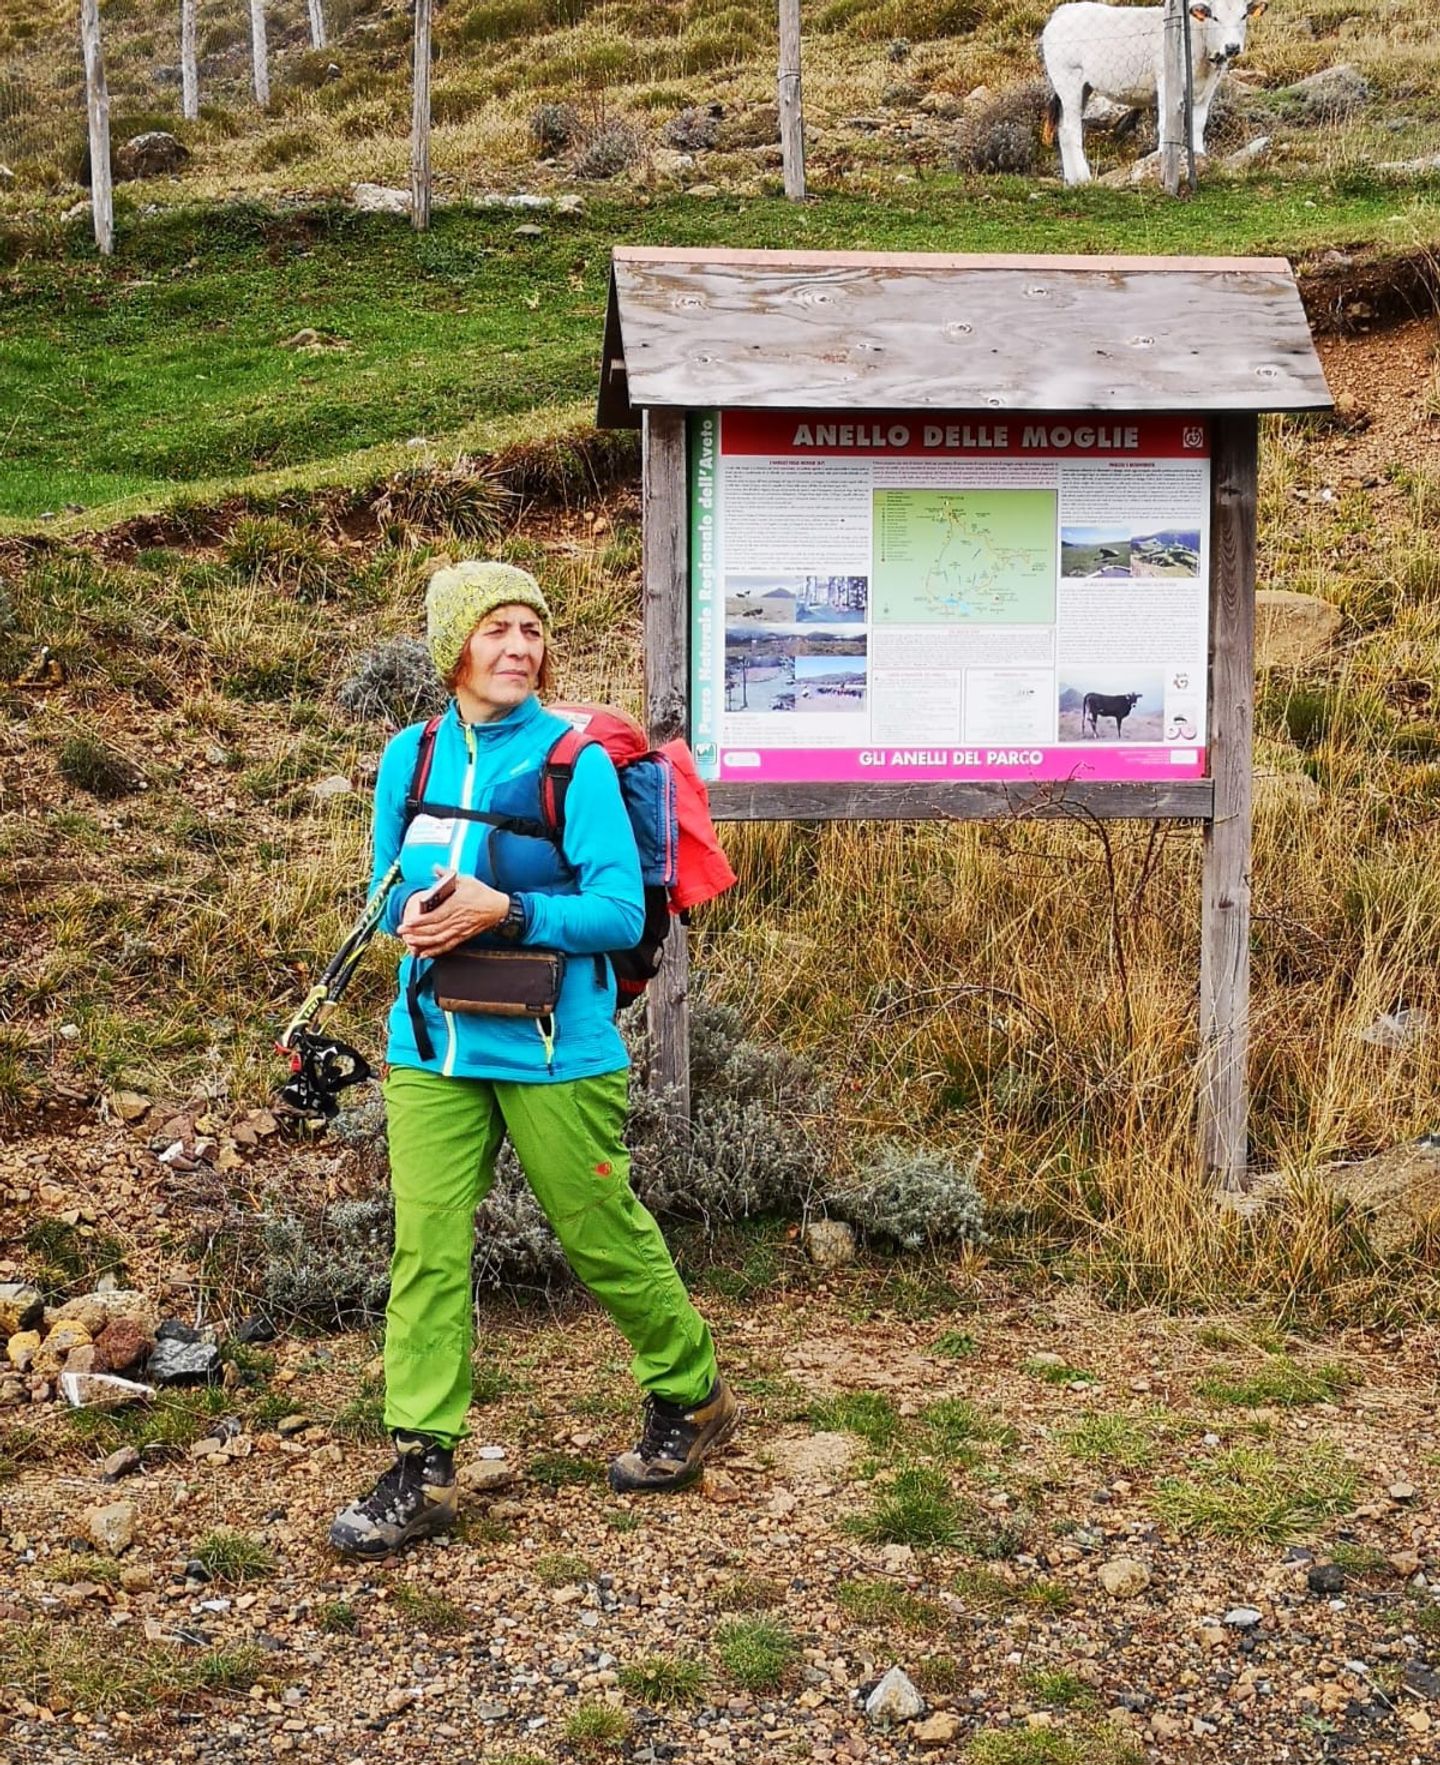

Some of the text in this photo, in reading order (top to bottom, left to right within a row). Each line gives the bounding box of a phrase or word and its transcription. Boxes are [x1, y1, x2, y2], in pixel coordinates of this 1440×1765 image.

[792, 424, 1139, 448] ANELLO DELLE MOGLIE
[698, 419, 715, 735] Parco Naturale Regionale dell'Aveto
[858, 750, 1043, 766] GLI ANELLI DEL PARCO
